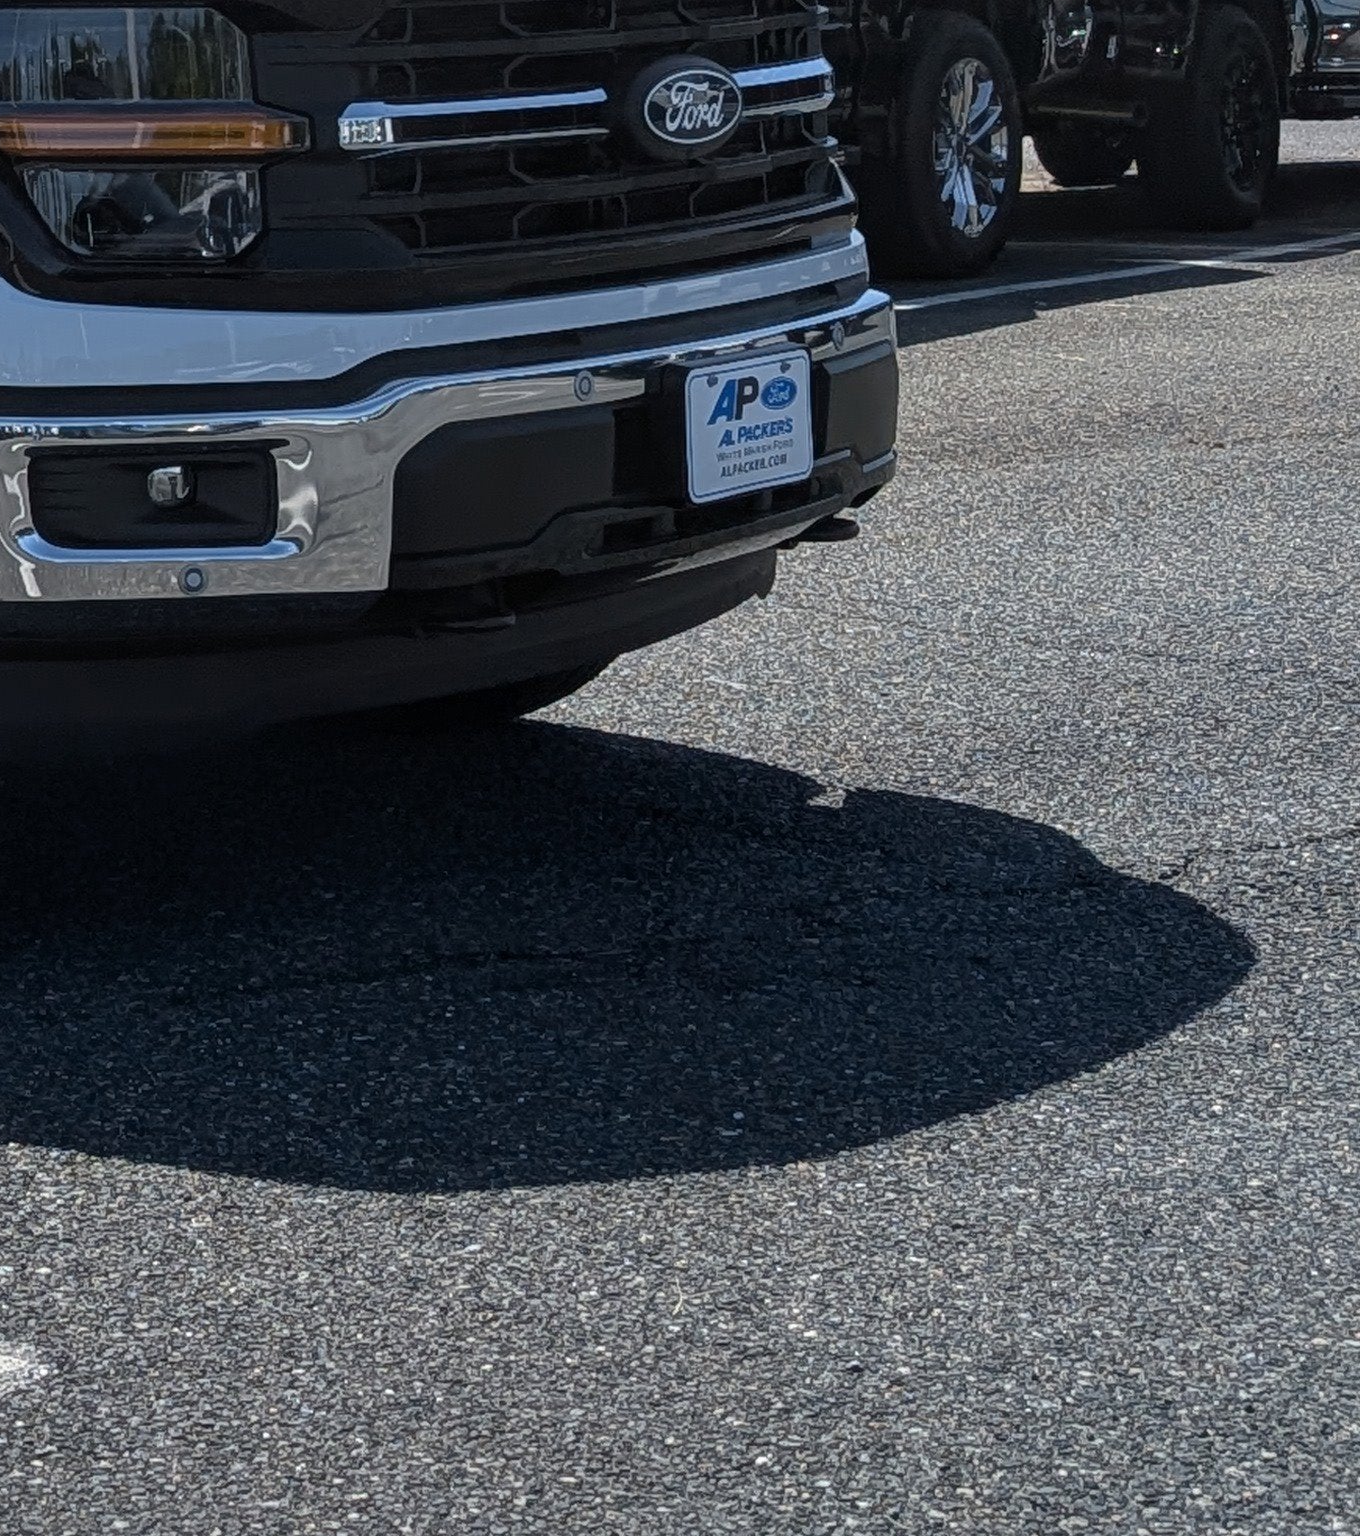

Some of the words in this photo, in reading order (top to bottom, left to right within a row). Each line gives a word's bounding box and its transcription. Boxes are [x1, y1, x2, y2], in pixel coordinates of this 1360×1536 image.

[665, 80, 725, 132] Ford
[707, 376, 759, 425] AP
[717, 428, 736, 448] AL
